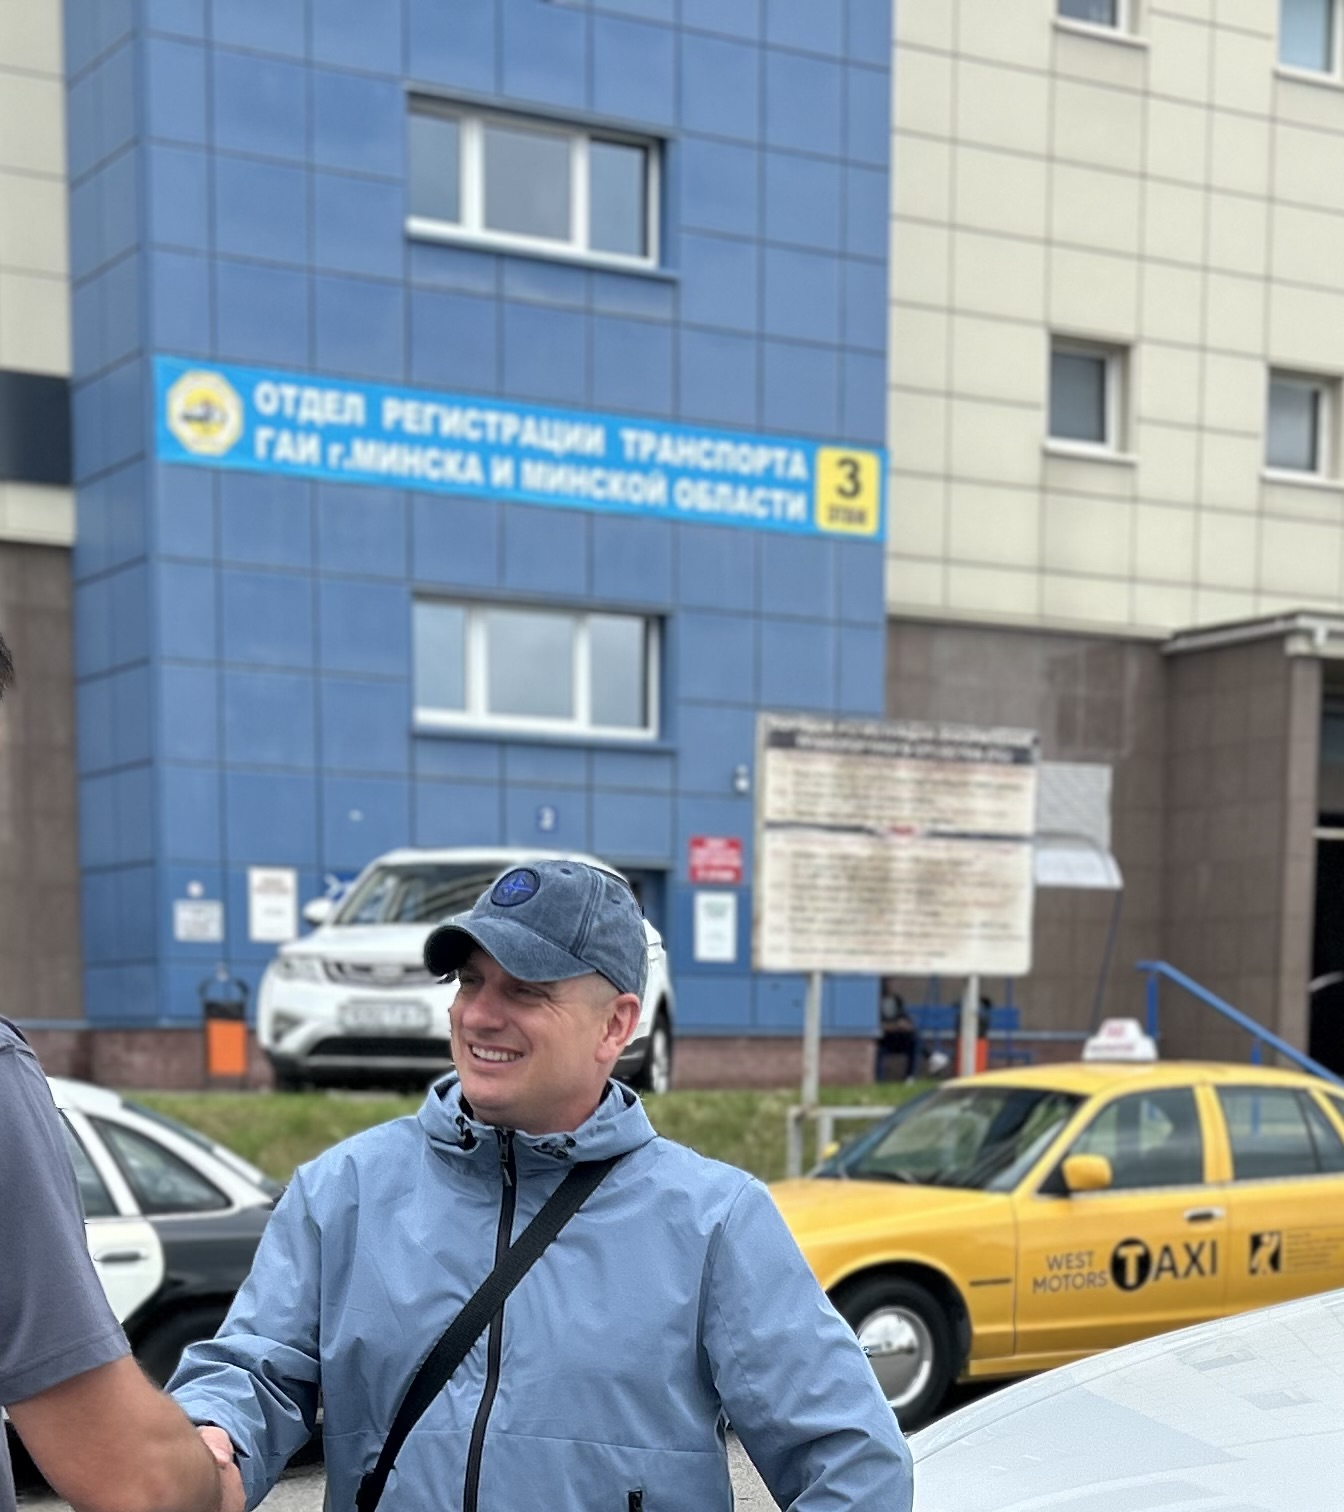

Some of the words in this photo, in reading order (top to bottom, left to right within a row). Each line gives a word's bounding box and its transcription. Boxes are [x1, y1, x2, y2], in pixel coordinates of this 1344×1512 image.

[254, 381, 367, 427] ОТДЕЛ
[382, 397, 606, 458] РЕГИСТРАЦИИ
[620, 428, 809, 480] ТРАНСПОРТА
[255, 427, 321, 467] ГАИ
[490, 455, 513, 488] И
[519, 457, 668, 508] МИНСКОЙ
[672, 476, 807, 522] ОБЛАСТИ
[835, 457, 863, 499] 3
[1032, 1271, 1107, 1294] MOTORS
[1046, 1251, 1096, 1271] WEST
[1110, 1237, 1217, 1291] TAXI
